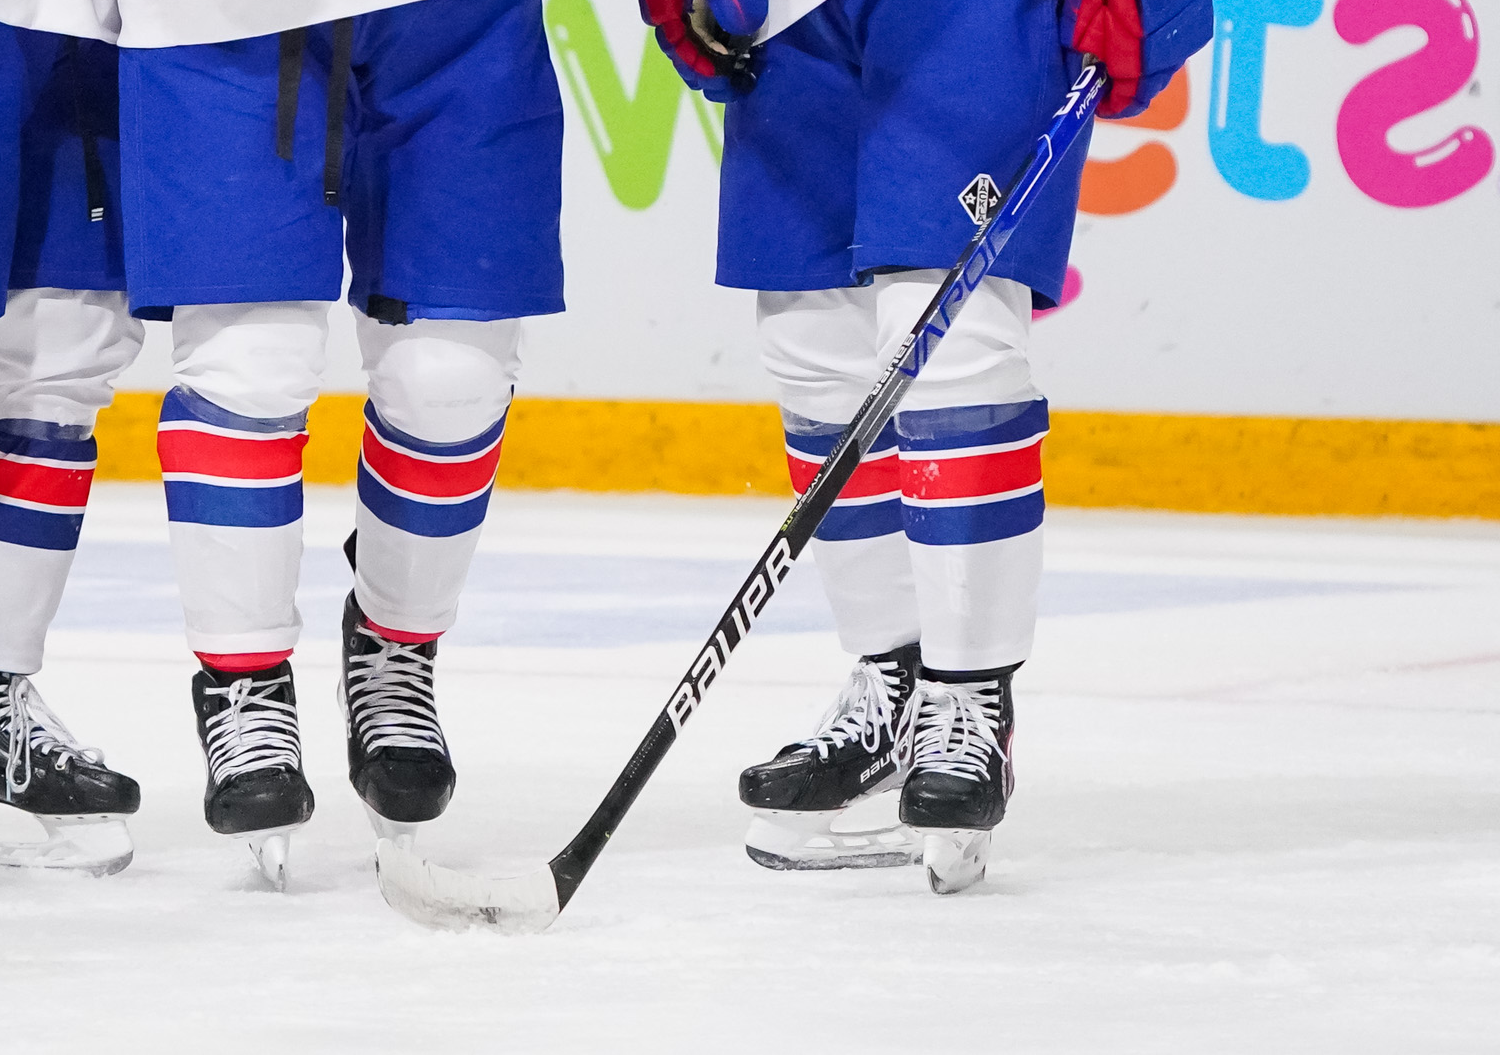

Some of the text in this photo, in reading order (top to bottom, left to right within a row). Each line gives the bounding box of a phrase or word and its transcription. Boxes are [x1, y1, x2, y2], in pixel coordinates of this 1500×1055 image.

[978, 177, 989, 222] TACKLA
[871, 333, 916, 396] BAUER
[666, 537, 797, 737] BAUER
[859, 741, 912, 784] BAUR
